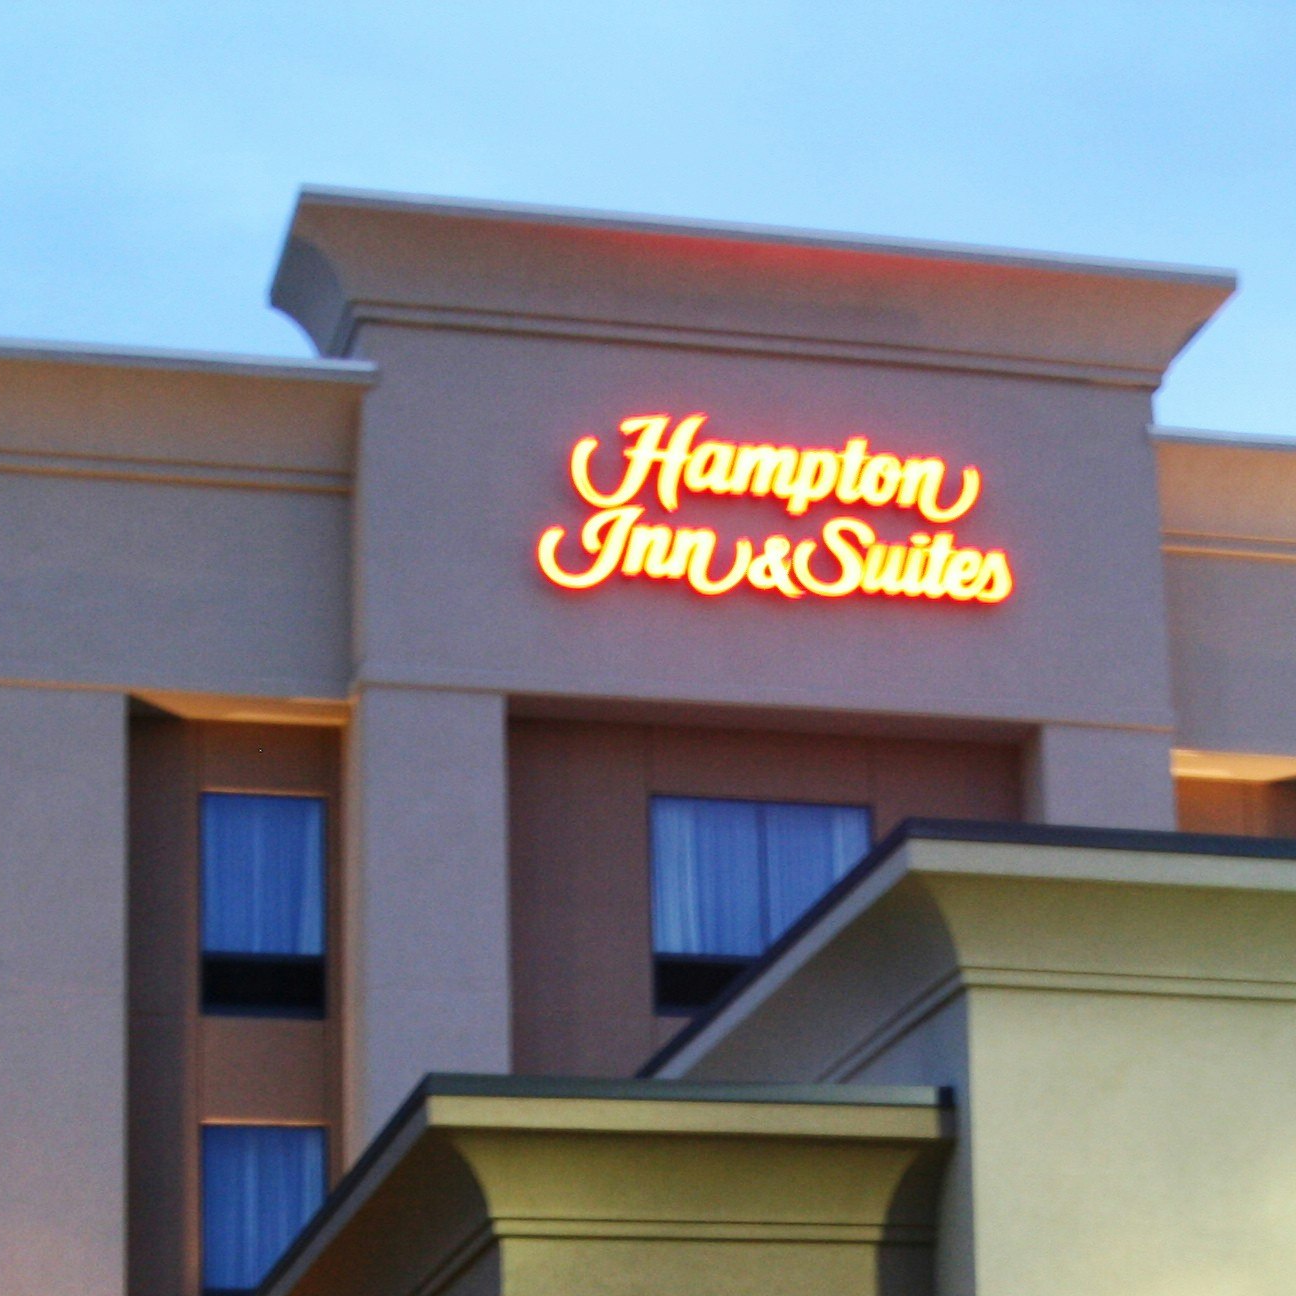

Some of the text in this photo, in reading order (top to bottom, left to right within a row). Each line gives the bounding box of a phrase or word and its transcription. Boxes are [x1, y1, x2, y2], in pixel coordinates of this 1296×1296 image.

[569, 411, 981, 523] Hampton
[537, 504, 752, 596] Inn
[794, 516, 1013, 603] Suites
